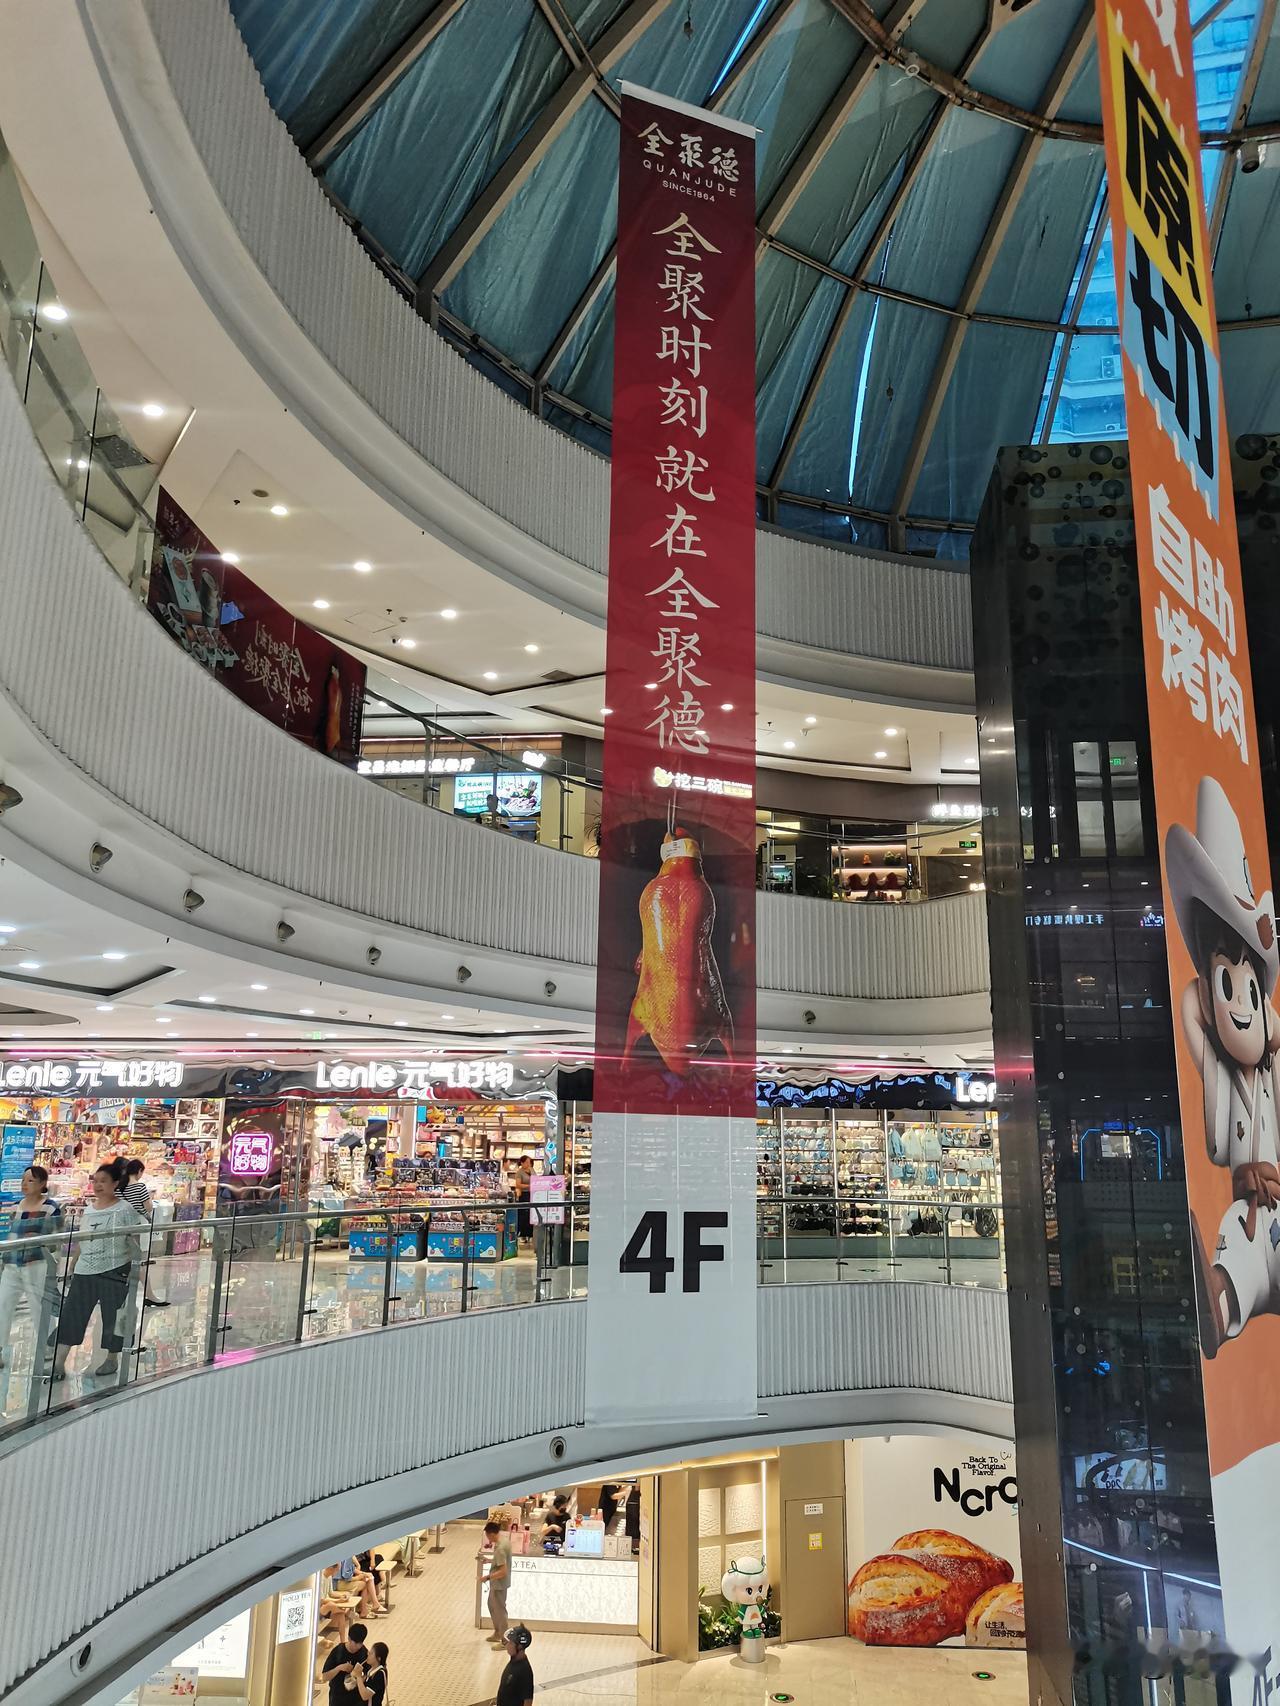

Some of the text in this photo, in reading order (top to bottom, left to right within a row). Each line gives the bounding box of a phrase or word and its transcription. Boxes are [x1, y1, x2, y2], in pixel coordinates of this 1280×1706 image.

[637, 121, 741, 183] 全聚德
[642, 159, 738, 198] QUANJUDE
[644, 212, 721, 755] 全聚时刻就在全聚德
[1148, 483, 1236, 657] 自助
[1154, 590, 1249, 766] 烤肉
[76, 1061, 184, 1088] 元气好物
[316, 1060, 514, 1089] Lenle 元气好物
[233, 1137, 269, 1152] 元气
[233, 1154, 268, 1171] 好物
[619, 1211, 728, 1293] 4F
[978, 1462, 1007, 1472] Original
[520, 1561, 537, 1570] TEA
